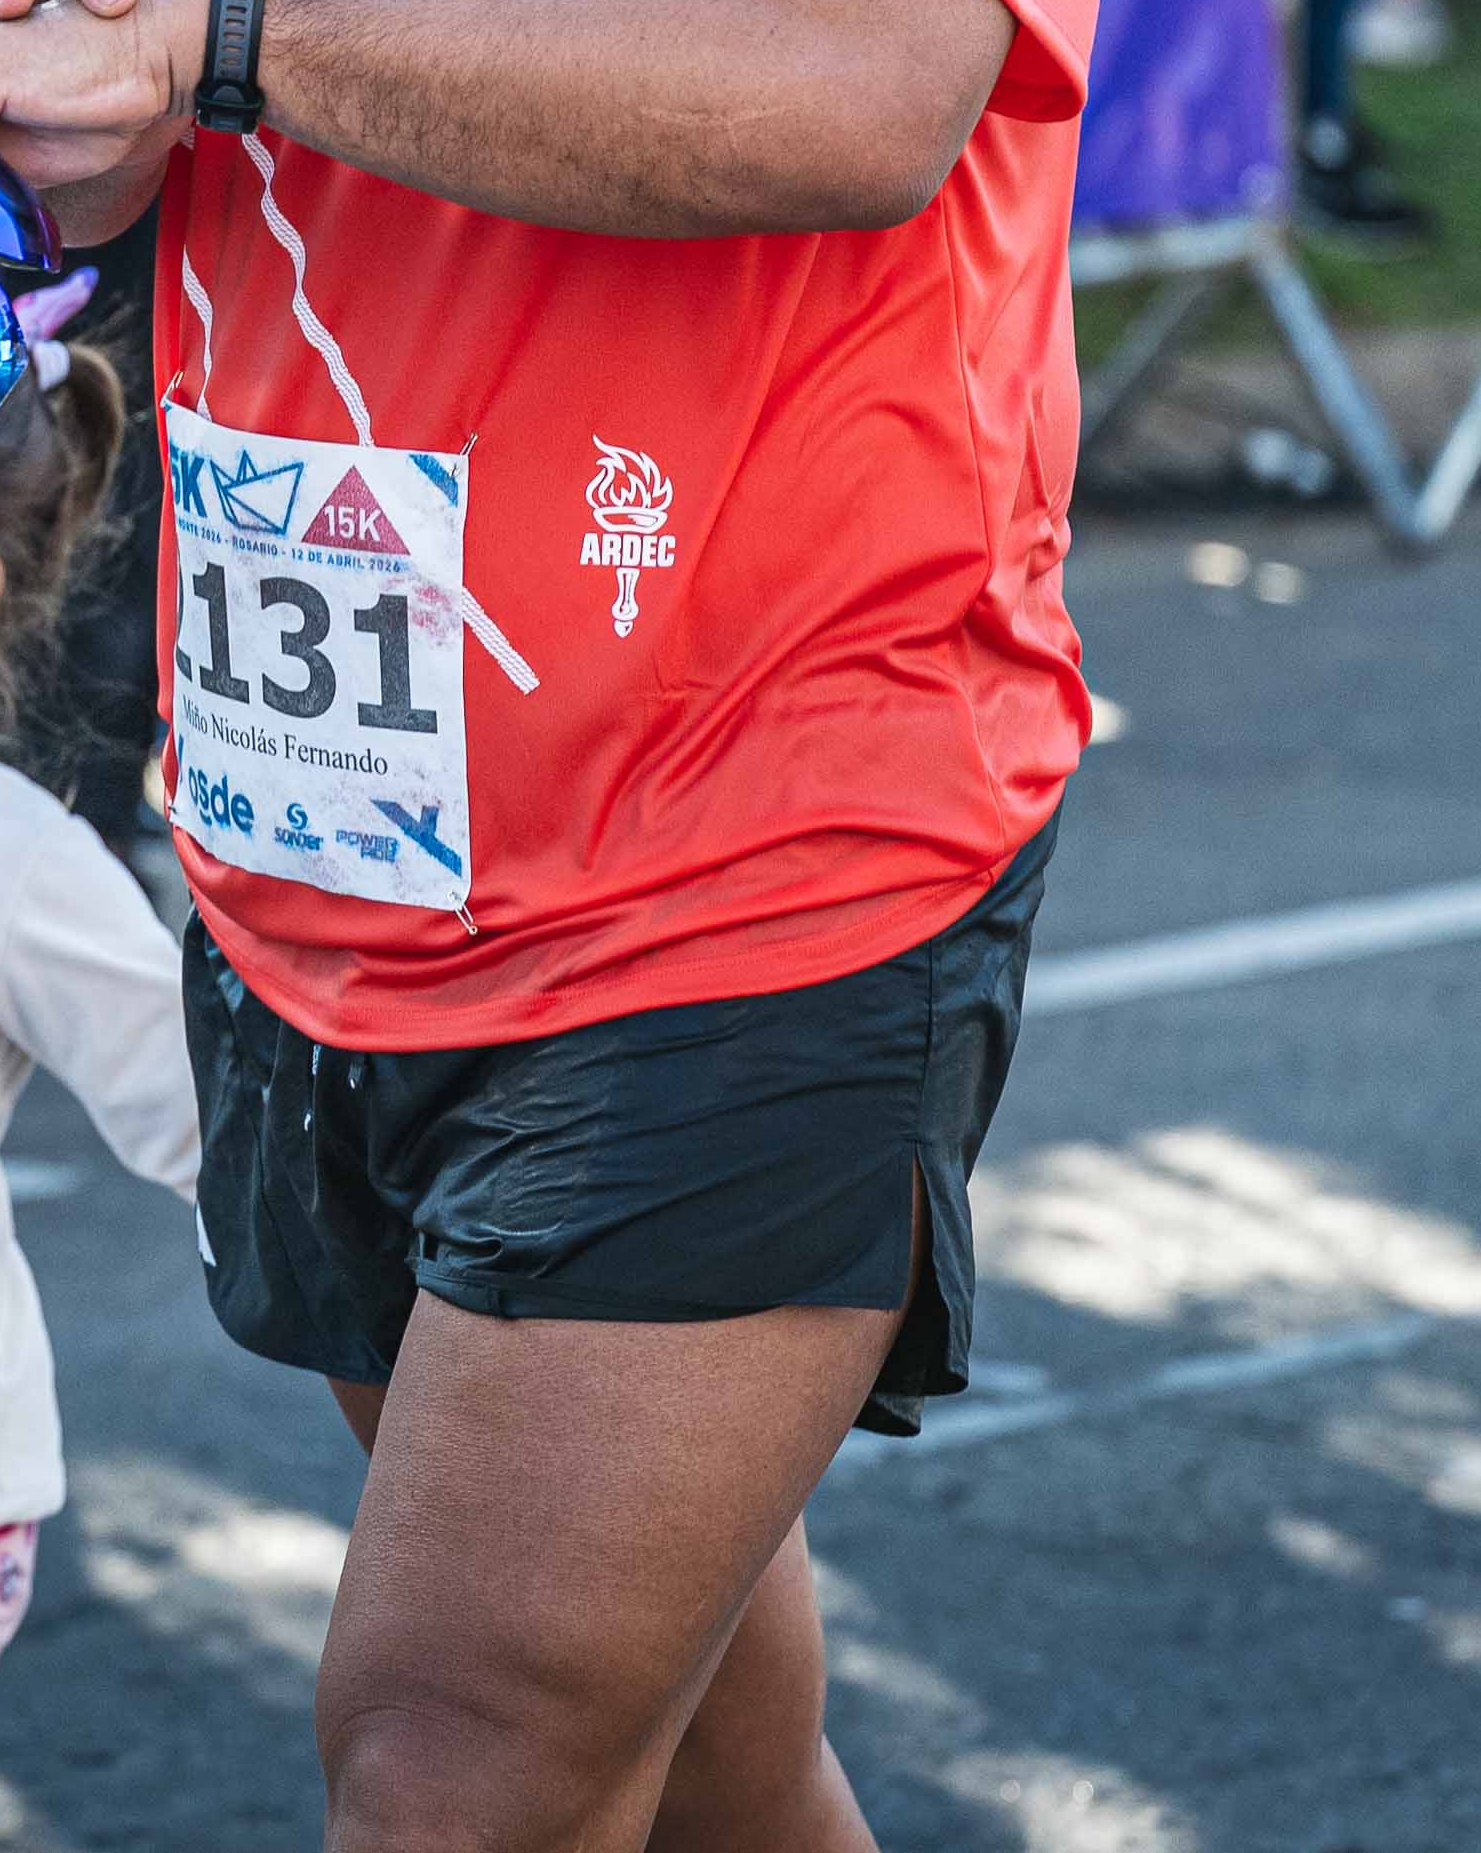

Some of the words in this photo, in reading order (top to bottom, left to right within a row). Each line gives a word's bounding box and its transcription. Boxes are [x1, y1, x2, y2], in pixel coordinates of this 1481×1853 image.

[324, 504, 382, 542] 15K
[201, 527, 222, 543] 2026
[232, 535, 278, 556] ROSARIO
[292, 548, 304, 560] 12
[308, 550, 323, 563] DE
[327, 553, 365, 569] ABRIL
[369, 558, 401, 573] 2026
[580, 532, 676, 567] ARDEC
[183, 694, 208, 734] Miño
[211, 714, 277, 757] Nicolás
[284, 733, 388, 776] Fernando
[188, 766, 254, 836] osde
